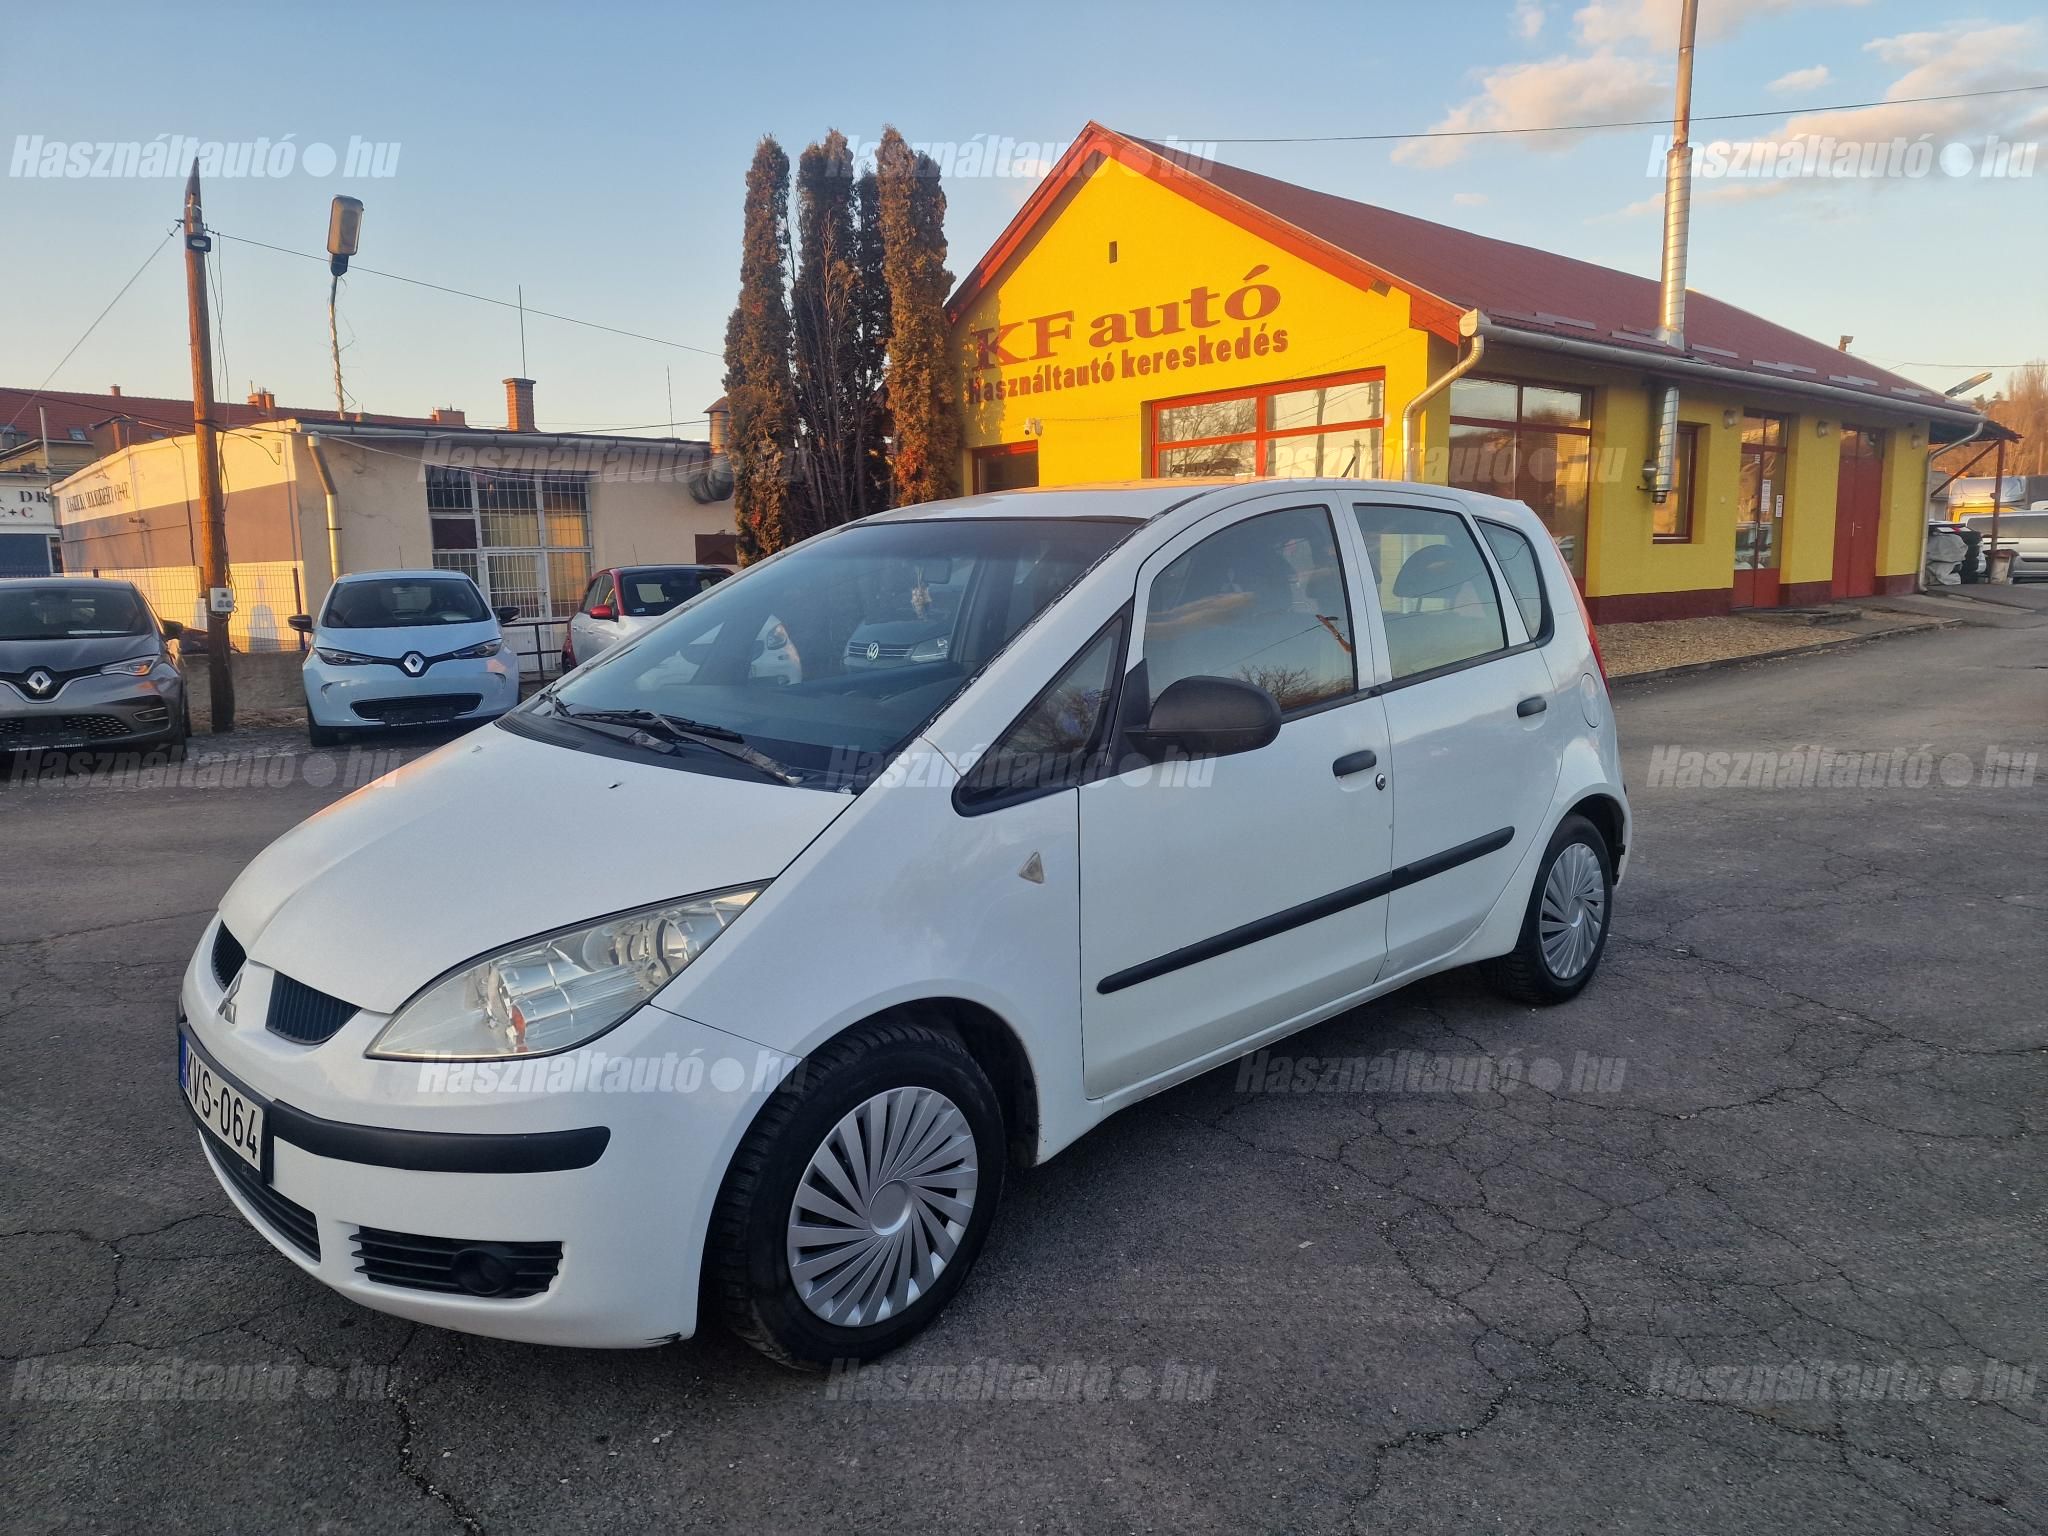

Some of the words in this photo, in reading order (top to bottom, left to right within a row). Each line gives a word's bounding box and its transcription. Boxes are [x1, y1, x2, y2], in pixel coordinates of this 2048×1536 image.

[970, 310, 1074, 370] KF
[1088, 264, 1281, 348] autó
[1121, 323, 1289, 379] kereskedés
[187, 1052, 258, 1160] KVS-064
